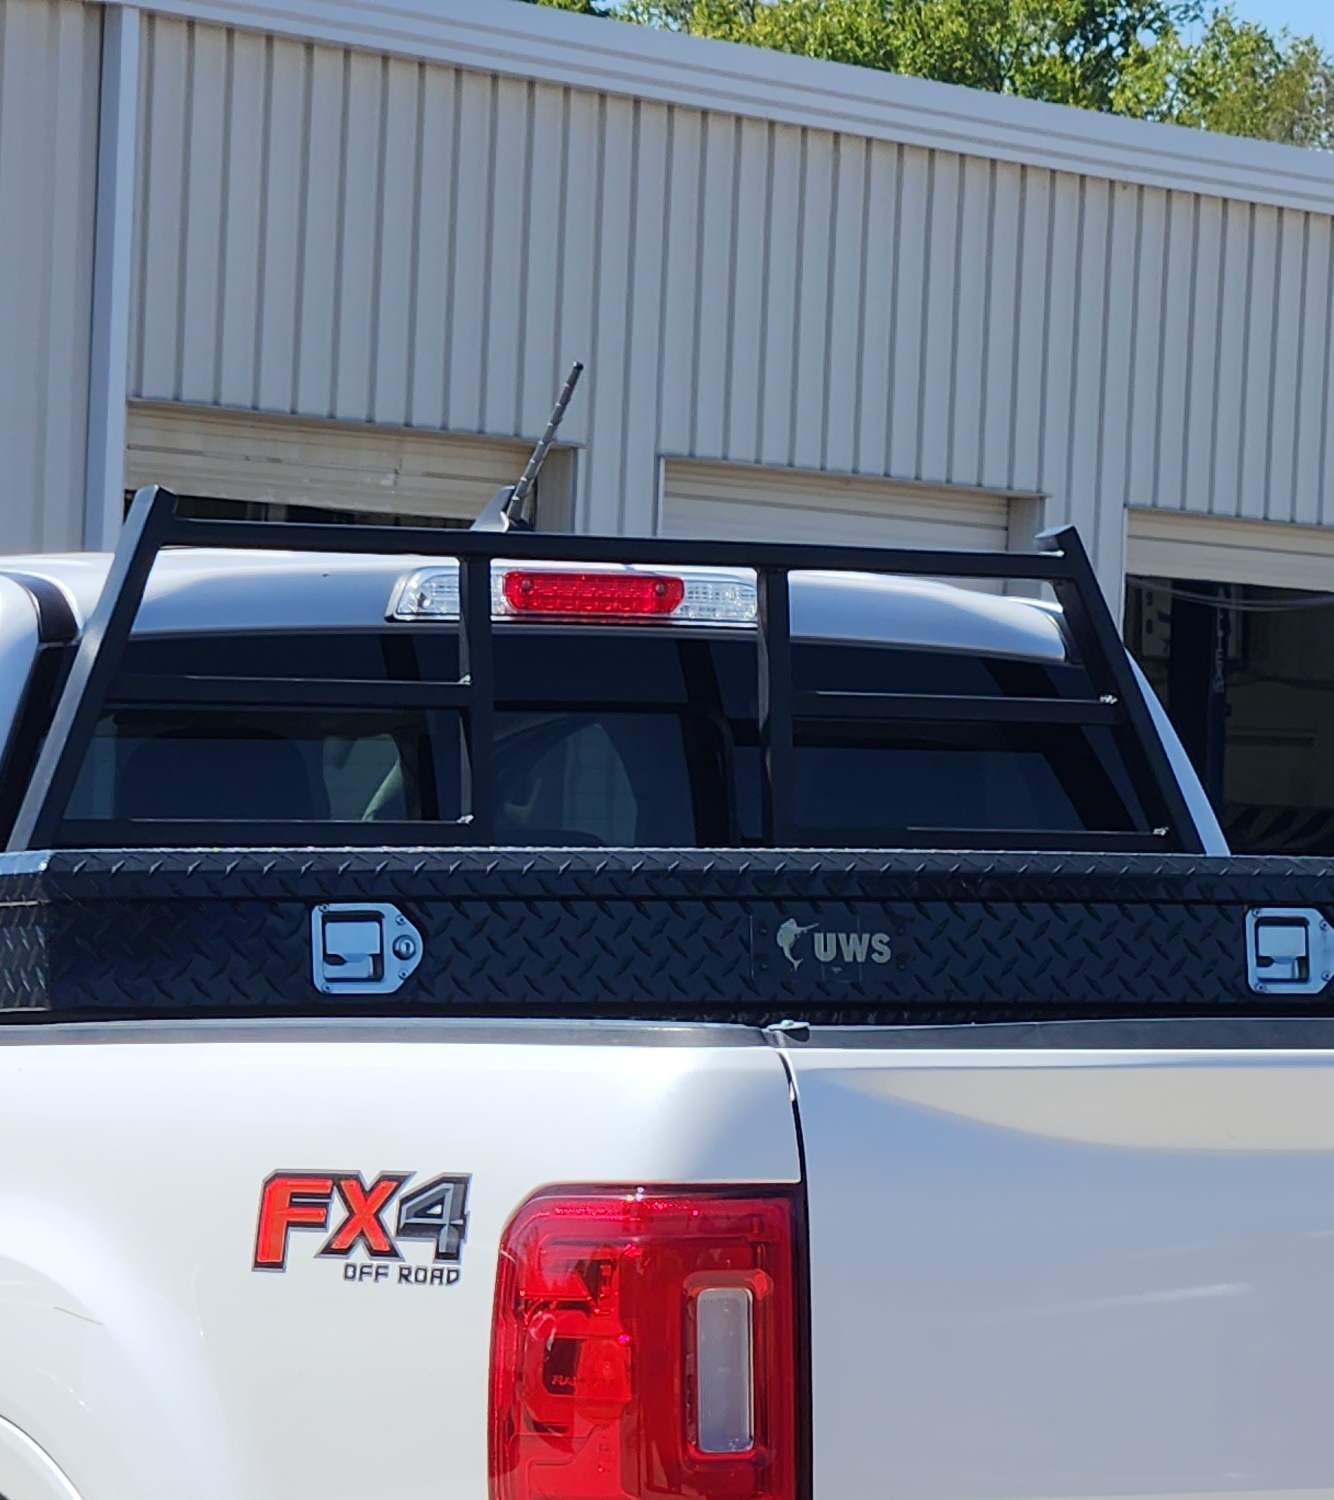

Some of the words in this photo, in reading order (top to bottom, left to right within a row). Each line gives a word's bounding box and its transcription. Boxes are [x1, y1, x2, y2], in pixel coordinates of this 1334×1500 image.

[813, 932, 892, 964] UWS
[251, 1168, 473, 1273] FX4
[343, 1261, 390, 1284] OFF
[397, 1263, 461, 1286] ROAD
